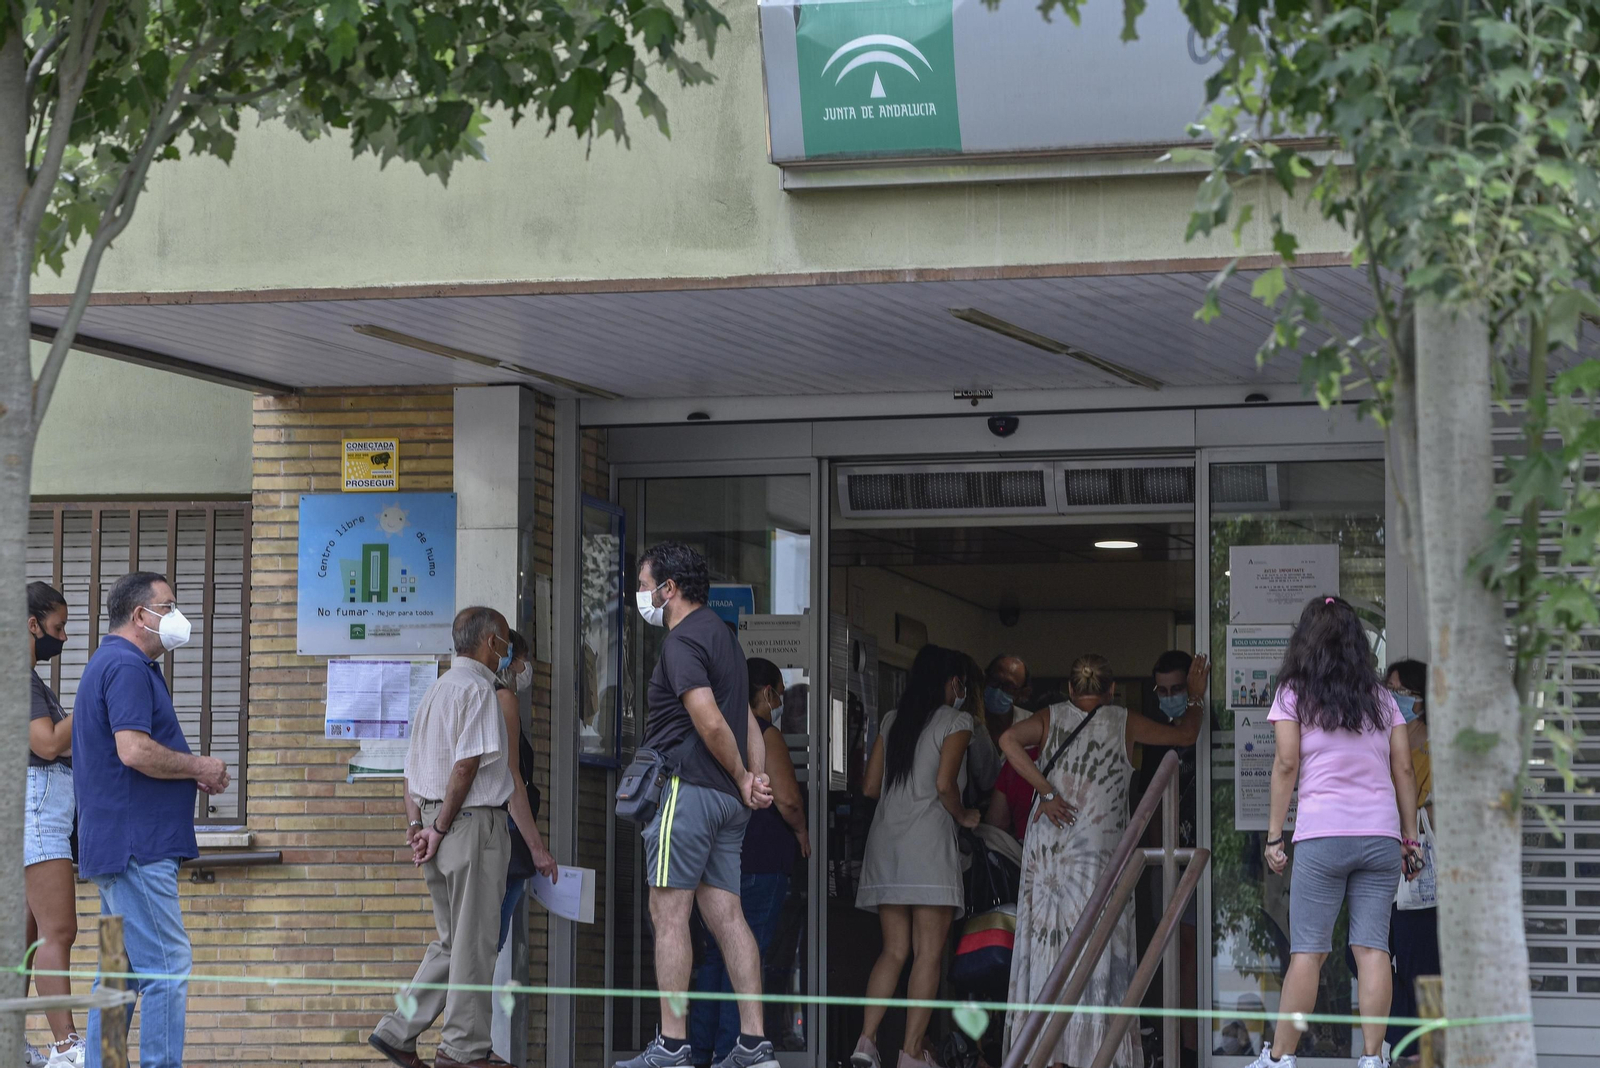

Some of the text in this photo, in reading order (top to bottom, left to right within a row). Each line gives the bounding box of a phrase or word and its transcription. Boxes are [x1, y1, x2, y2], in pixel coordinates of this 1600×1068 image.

[823, 102, 937, 121] JUNTA DE ANDALUCIA
[318, 515, 436, 578] Centro libre de humo
[317, 607, 369, 617] No fumar
